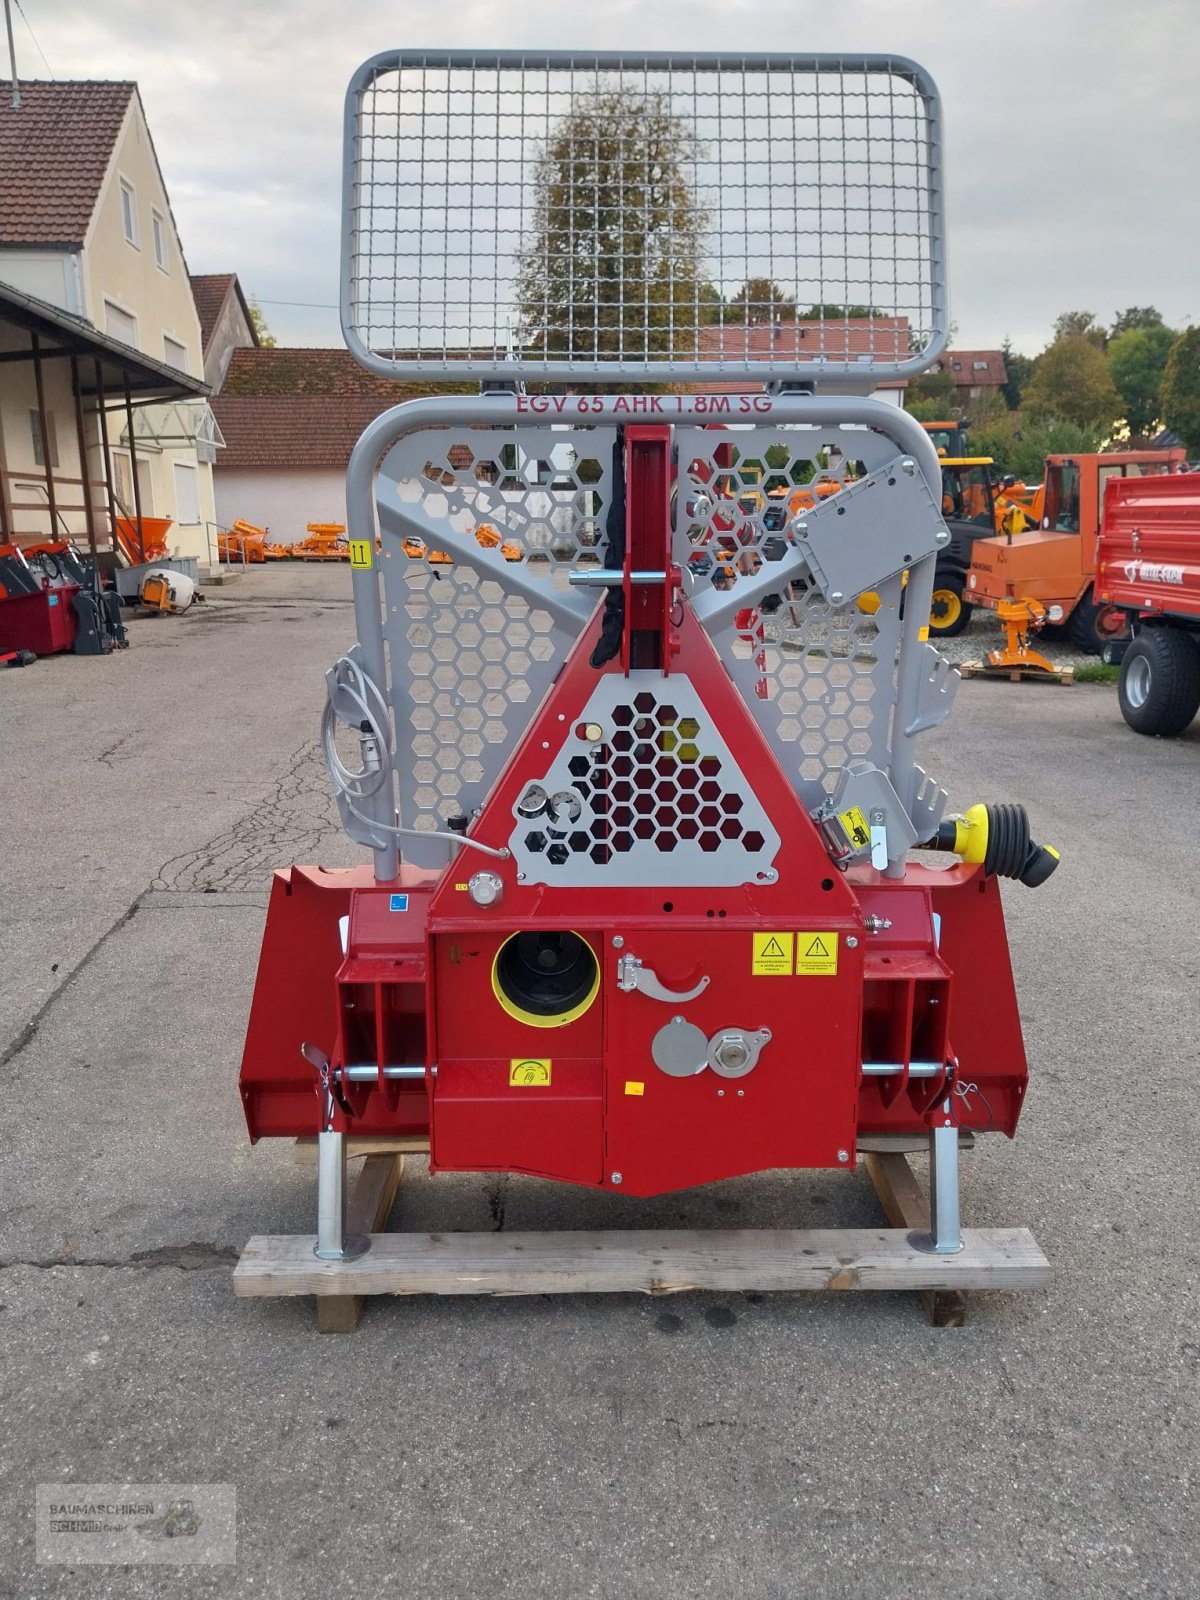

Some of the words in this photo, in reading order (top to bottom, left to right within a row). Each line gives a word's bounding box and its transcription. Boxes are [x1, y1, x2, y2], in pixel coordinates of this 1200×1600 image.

[516, 396, 568, 413] EGV
[577, 396, 604, 413] 65
[612, 396, 664, 413] AHK
[676, 396, 731, 413] 1.8M
[739, 396, 773, 413] SG
